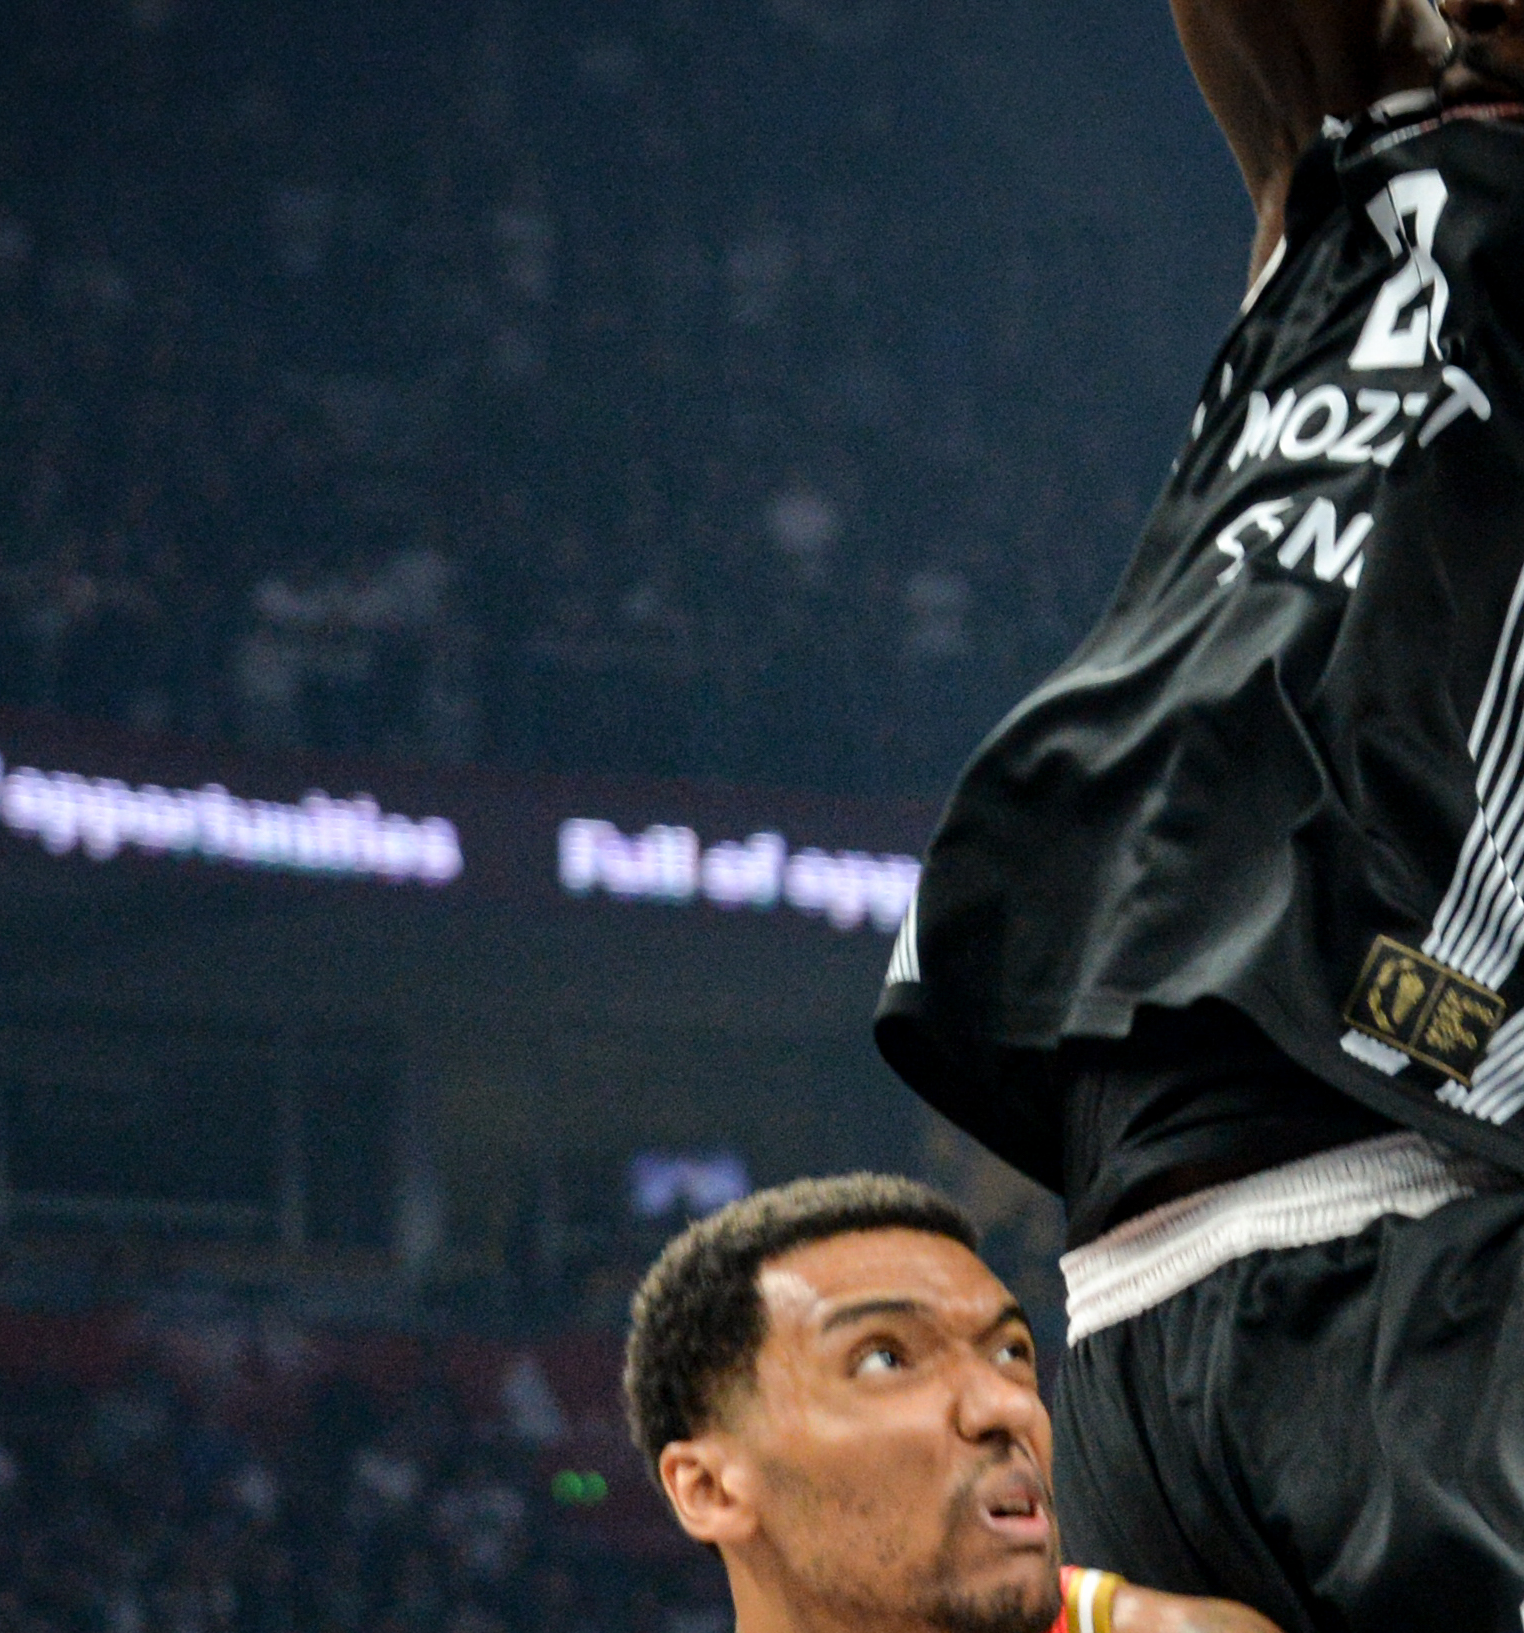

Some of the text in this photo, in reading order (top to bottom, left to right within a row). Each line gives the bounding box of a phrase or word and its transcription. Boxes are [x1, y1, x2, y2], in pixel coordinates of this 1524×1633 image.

[1347, 168, 1449, 371] 2
[1, 765, 463, 886] opportunities
[558, 817, 699, 900] Full
[701, 830, 785, 912] of
